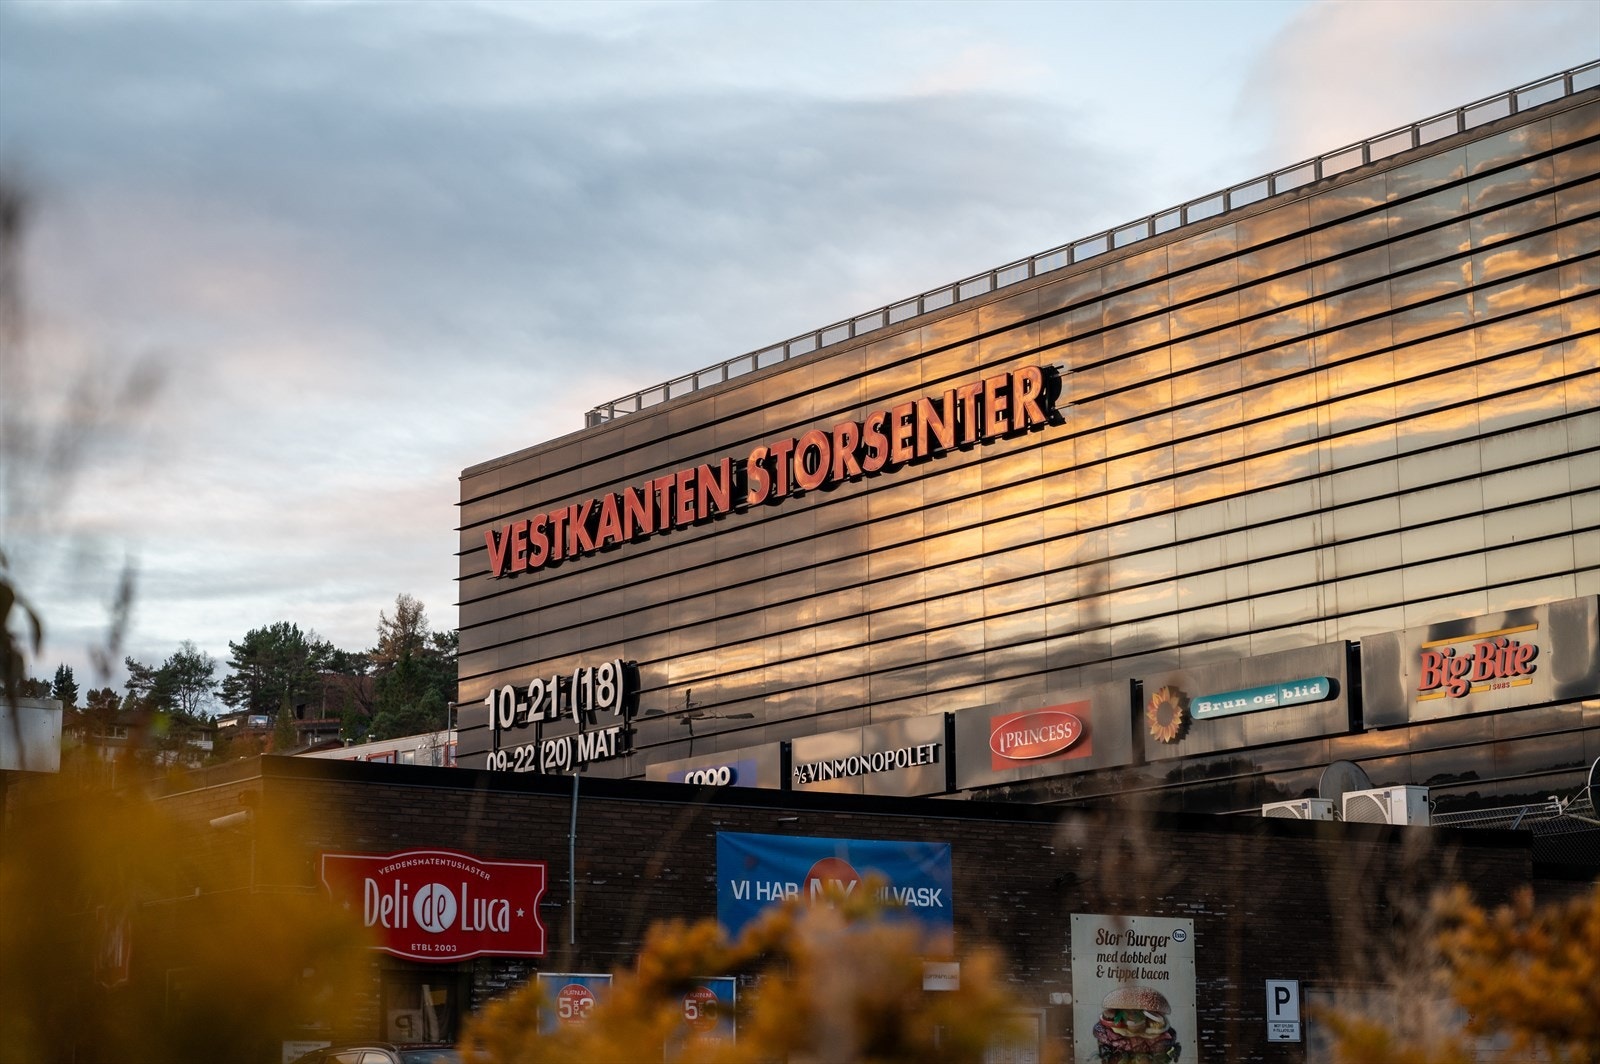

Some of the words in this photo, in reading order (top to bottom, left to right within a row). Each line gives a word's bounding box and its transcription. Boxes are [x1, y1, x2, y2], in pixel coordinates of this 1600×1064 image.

[484, 457, 732, 577] VESTKANTEN
[747, 365, 1047, 505] STORSENTER
[1417, 647, 1471, 698] Big
[1470, 638, 1534, 682] Bite
[485, 675, 558, 731] 10-21
[571, 659, 624, 723] (18)
[1198, 698, 1247, 713] Brun
[1253, 693, 1276, 705] og
[1282, 683, 1321, 700] blid
[1006, 721, 1072, 748] PRINCESS
[540, 737, 572, 774] (20)
[577, 727, 620, 763] MAT
[807, 743, 937, 781] VINMONOPOLET
[378, 858, 491, 881] VERDENSMATENTUSIASTER
[731, 880, 750, 900] VI
[756, 881, 798, 901] HAR
[364, 877, 408, 929] Deli
[419, 883, 451, 931] de
[461, 882, 510, 932] Luca
[435, 944, 457, 952] 2003
[1095, 928, 1123, 946] Stor
[1125, 929, 1171, 952] Burger
[1096, 951, 1118, 963] med
[1120, 951, 1152, 964] dobbel
[1153, 953, 1167, 964] ost
[1096, 965, 1105, 978] &
[1107, 966, 1139, 982] trippel
[1141, 967, 1169, 980] bacon
[559, 998, 572, 1018] 5
[684, 1000, 698, 1020] 5
[1275, 986, 1290, 1015] P
